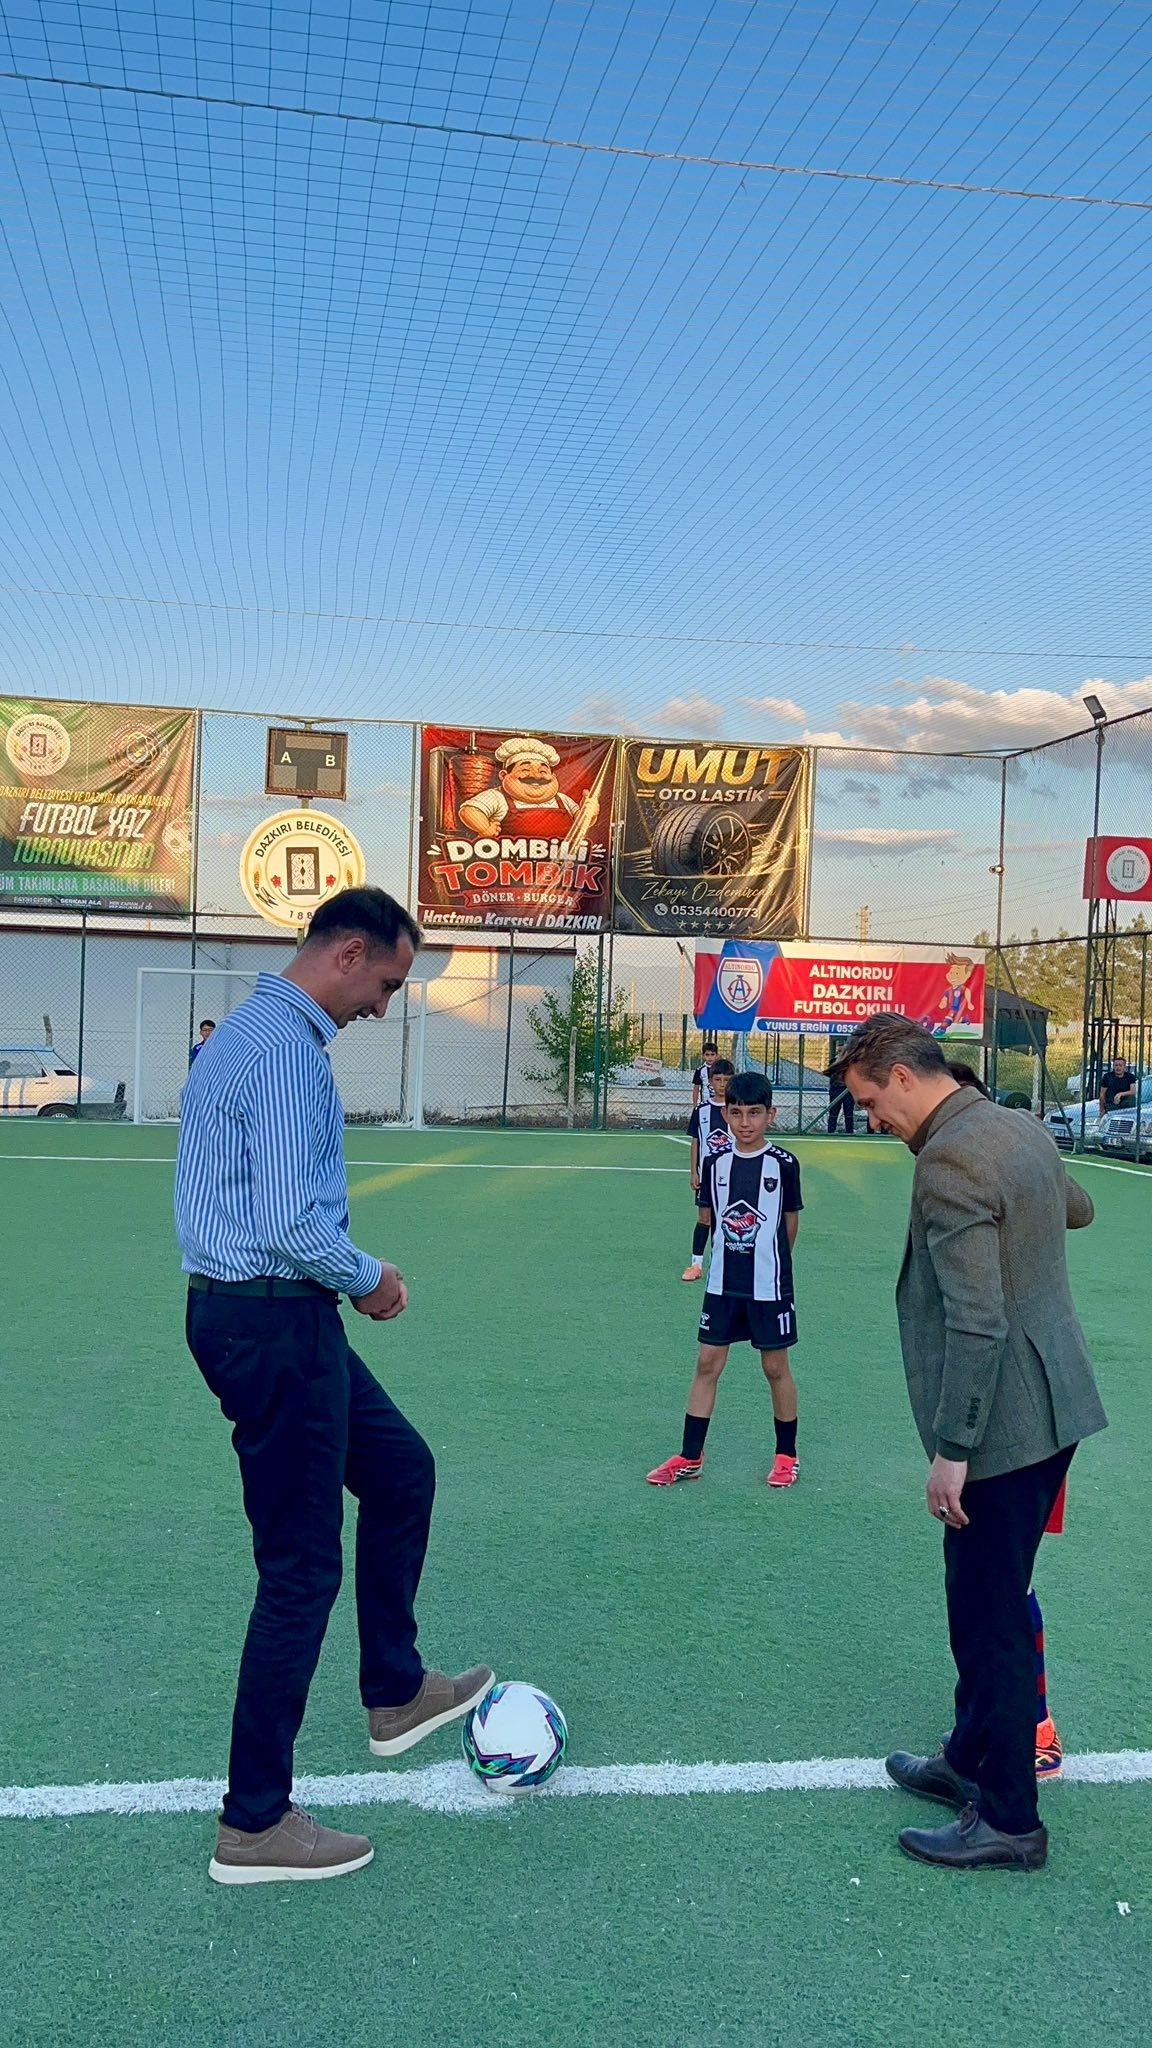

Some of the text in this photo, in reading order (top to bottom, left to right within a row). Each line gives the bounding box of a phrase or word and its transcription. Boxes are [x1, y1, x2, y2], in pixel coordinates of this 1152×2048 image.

[281, 751, 292, 764] A
[325, 754, 336, 767] B
[636, 748, 792, 785] UMUT
[659, 787, 765, 802] OTO LASTİK
[19, 801, 151, 838] FUTBOL YAZ
[255, 821, 353, 858] DAZKIRI BELEDİYESİ
[473, 892, 573, 907] DÖNER BURGER
[640, 879, 688, 904] Zekayi
[670, 904, 759, 918] 05354400773
[545, 914, 603, 930] DAZKIRI
[809, 964, 893, 981] ALTINORDU
[813, 983, 893, 1001] DAZKIRI
[794, 1000, 852, 1016] FUTBOL
[765, 1021, 798, 1031] YUNUS
[800, 1021, 830, 1033] ERGİN
[777, 1311, 791, 1336] 11
